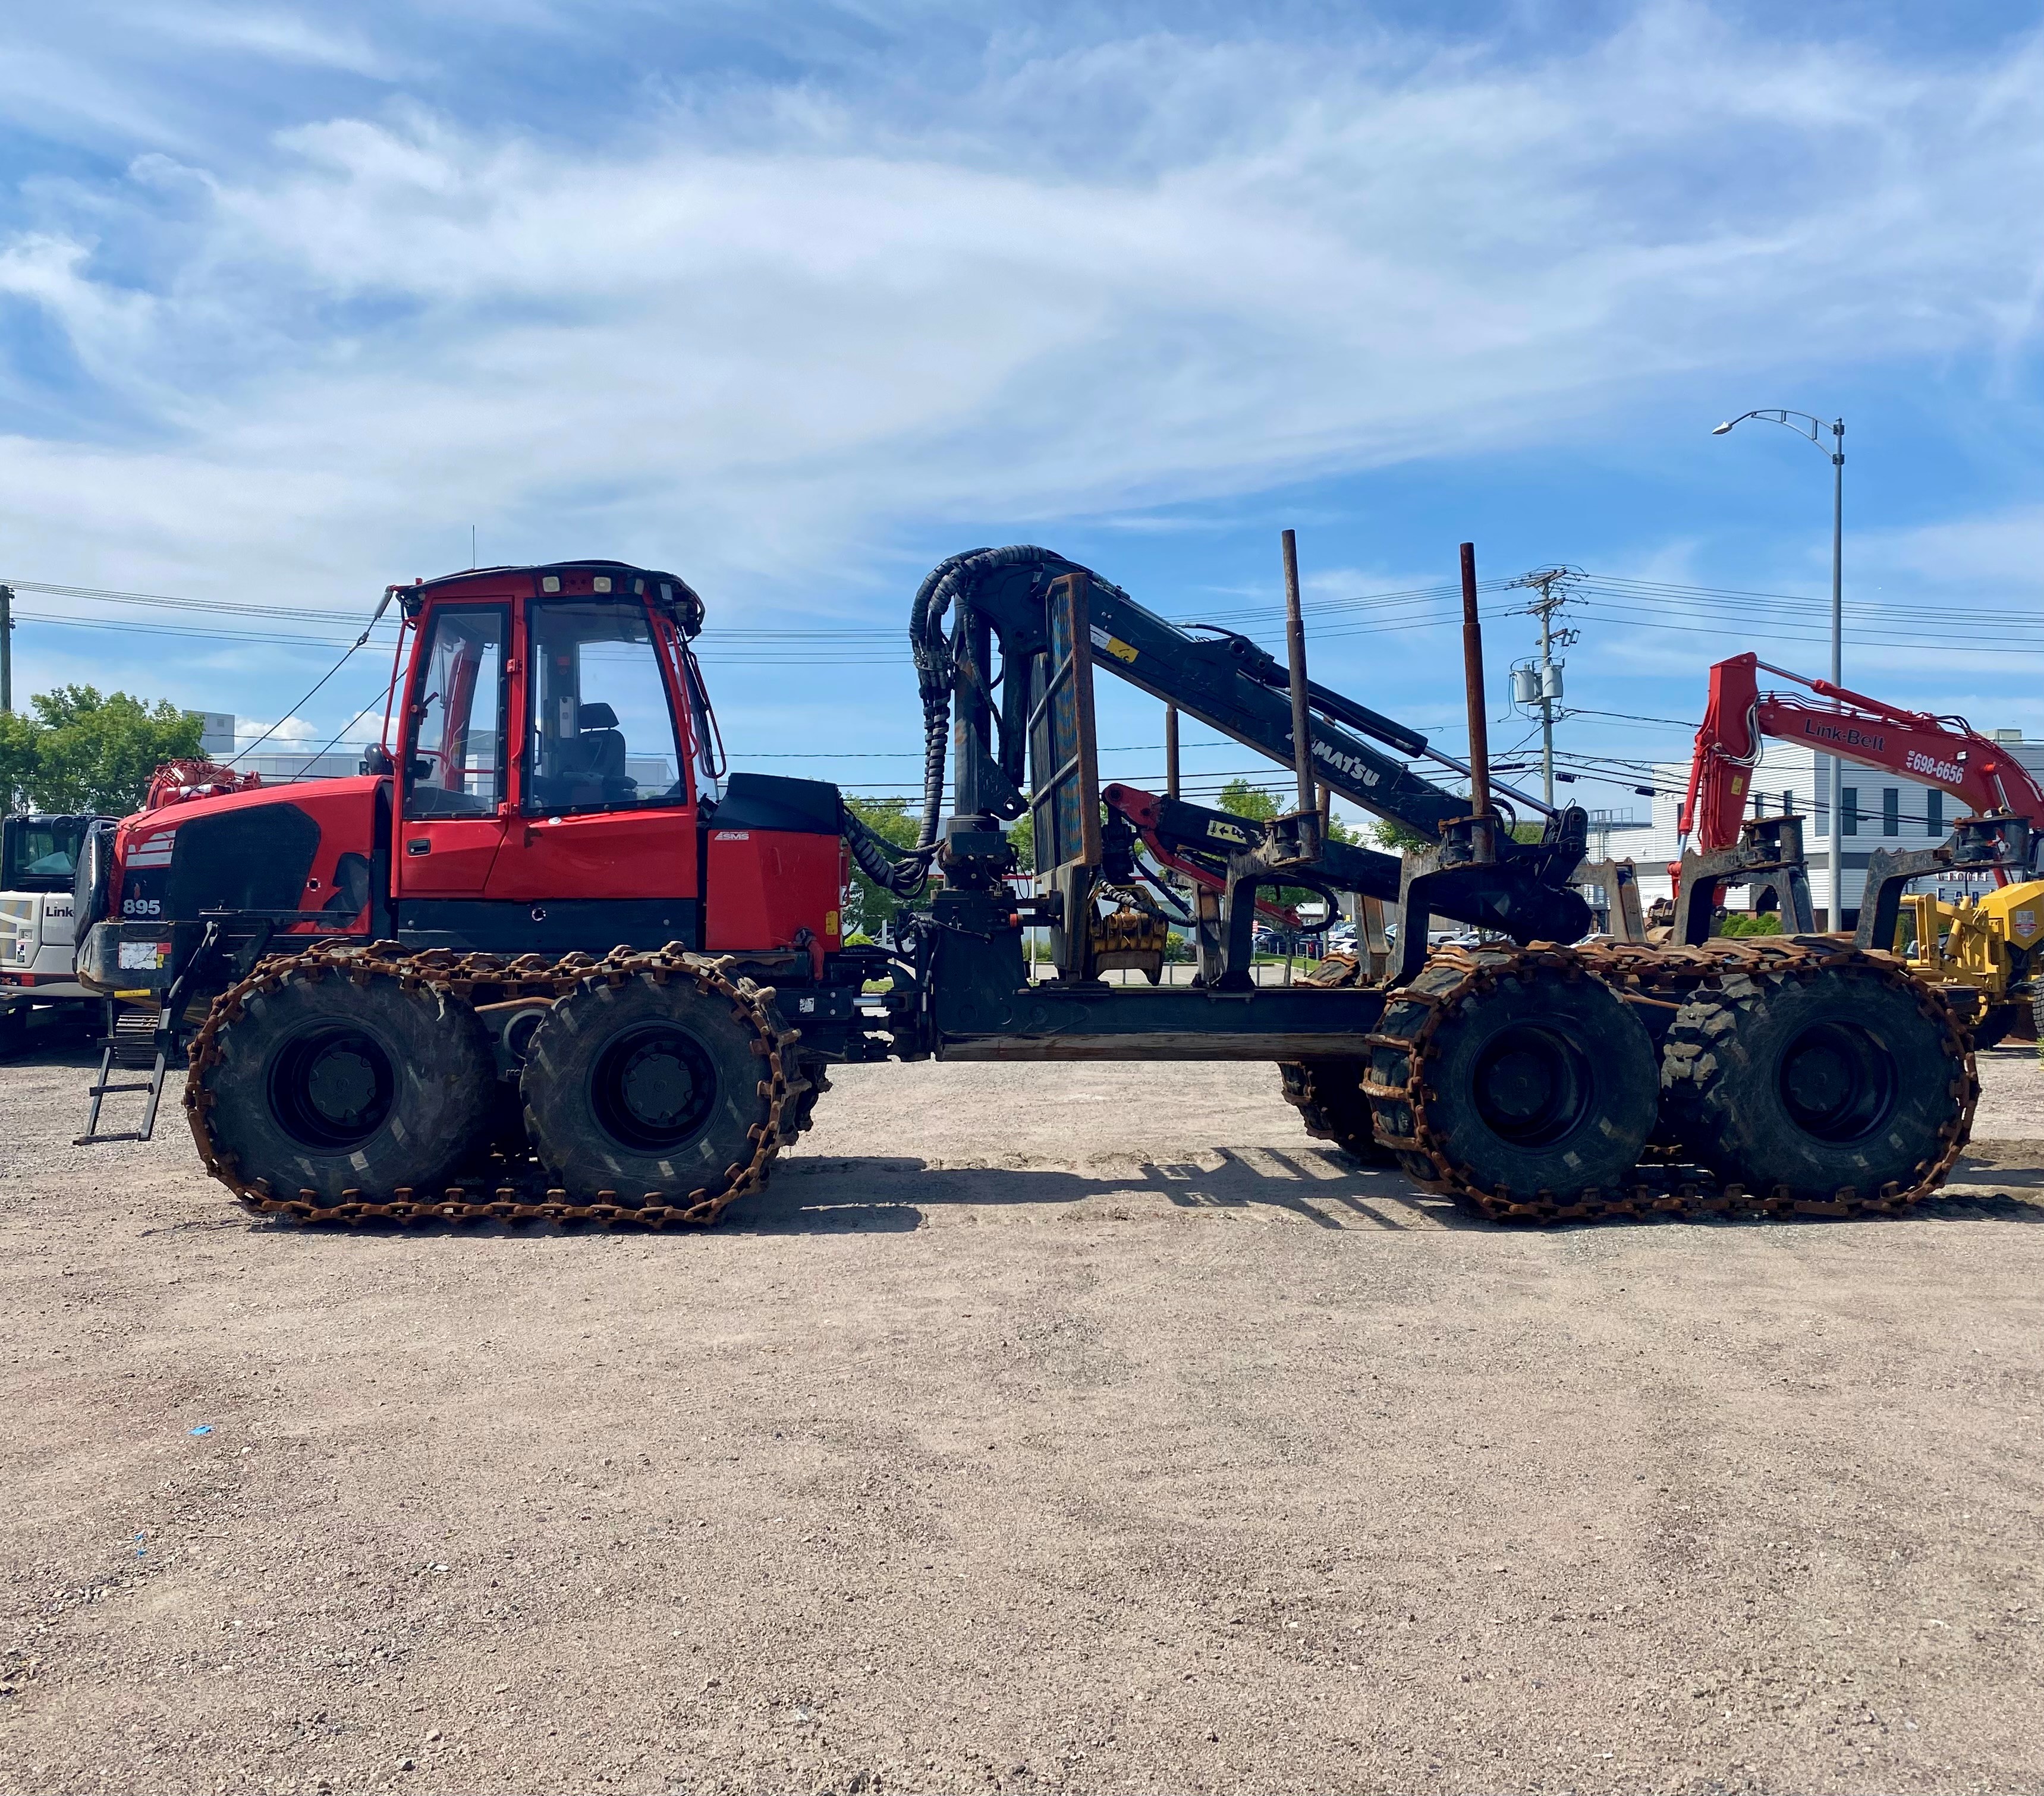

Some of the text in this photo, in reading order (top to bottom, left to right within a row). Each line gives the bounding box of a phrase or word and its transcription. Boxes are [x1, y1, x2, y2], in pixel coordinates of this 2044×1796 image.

[1805, 718, 1885, 752] Link-Belt
[1285, 725, 1380, 787] MATSU
[1906, 750, 1964, 784] 418 698-6656
[123, 899, 161, 914] 895
